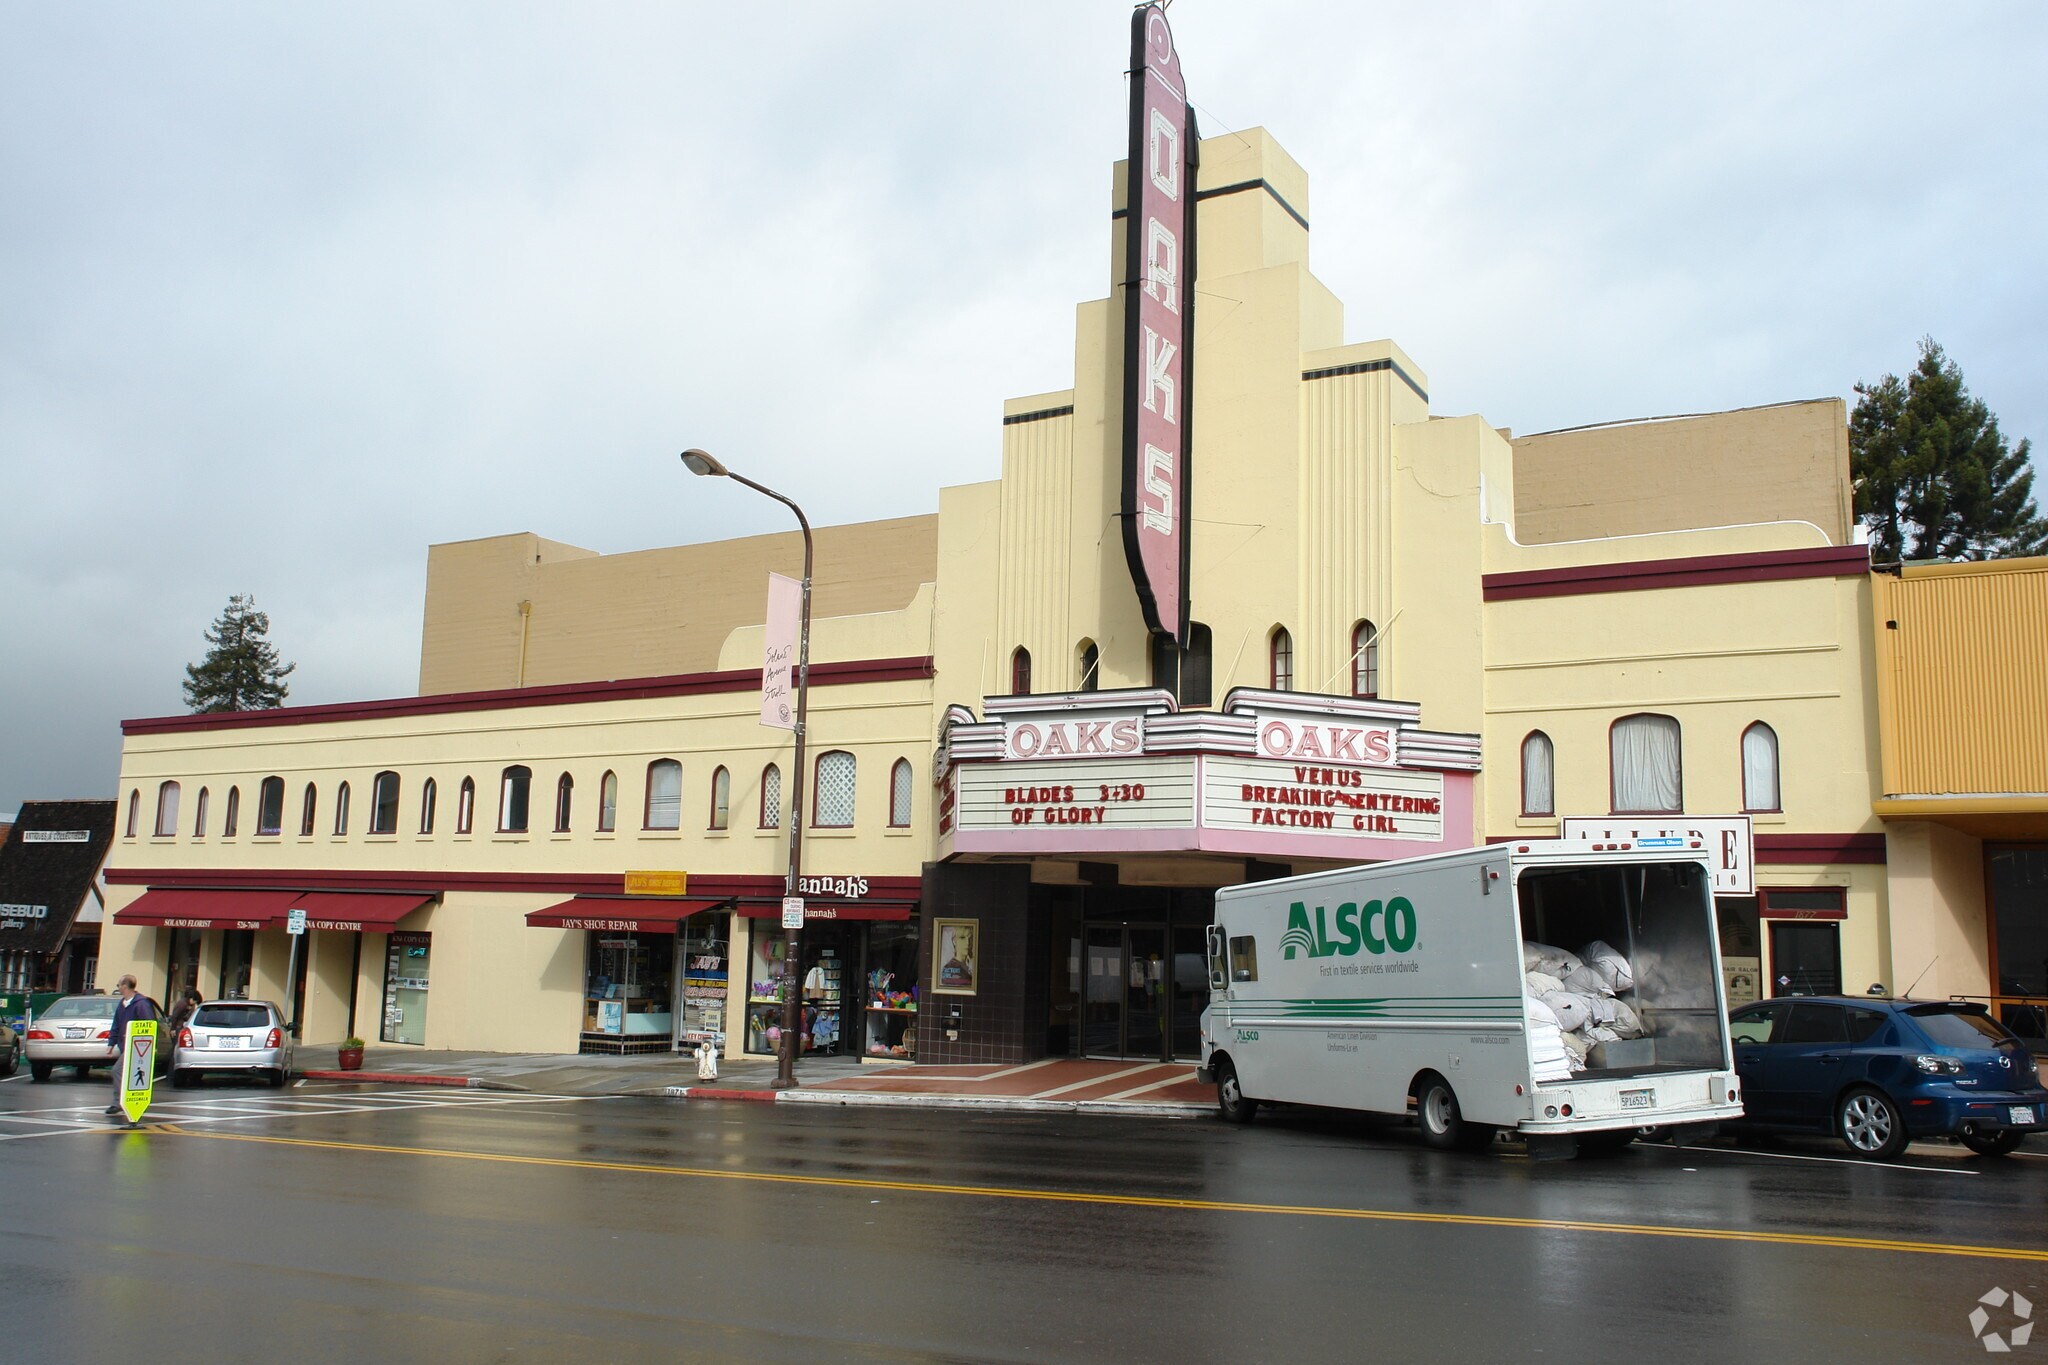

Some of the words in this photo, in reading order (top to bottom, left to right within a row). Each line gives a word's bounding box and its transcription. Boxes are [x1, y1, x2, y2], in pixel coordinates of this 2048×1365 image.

[1143, 107, 1180, 537] OAKS
[1011, 718, 1140, 758] OAKS
[1261, 721, 1391, 762] OAKS
[1294, 766, 1362, 788] VENUS
[1004, 785, 1075, 805] BLADES
[1241, 784, 1336, 807] BREAKING
[1355, 793, 1441, 815] ENTERING
[1011, 807, 1035, 825] OF
[1044, 806, 1106, 825] GLORY
[1252, 807, 1336, 829] FACTORY
[1352, 814, 1398, 833] GIRL
[164, 919, 187, 927] SOLANO
[187, 919, 212, 928] FLORIST
[804, 908, 837, 919] hannah's
[316, 920, 334, 930] COPY
[335, 921, 362, 931] CENTRE
[562, 919, 582, 929] JAY'S
[584, 920, 606, 930] SHOE
[608, 920, 638, 931] REPAIR
[1278, 896, 1417, 960] ALSCO
[1319, 965, 1333, 977] First
[1332, 964, 1339, 976] in
[1339, 963, 1359, 976] textile
[1360, 961, 1384, 975] services
[1384, 960, 1419, 974] worldwide
[1236, 1029, 1259, 1041] ALSCO
